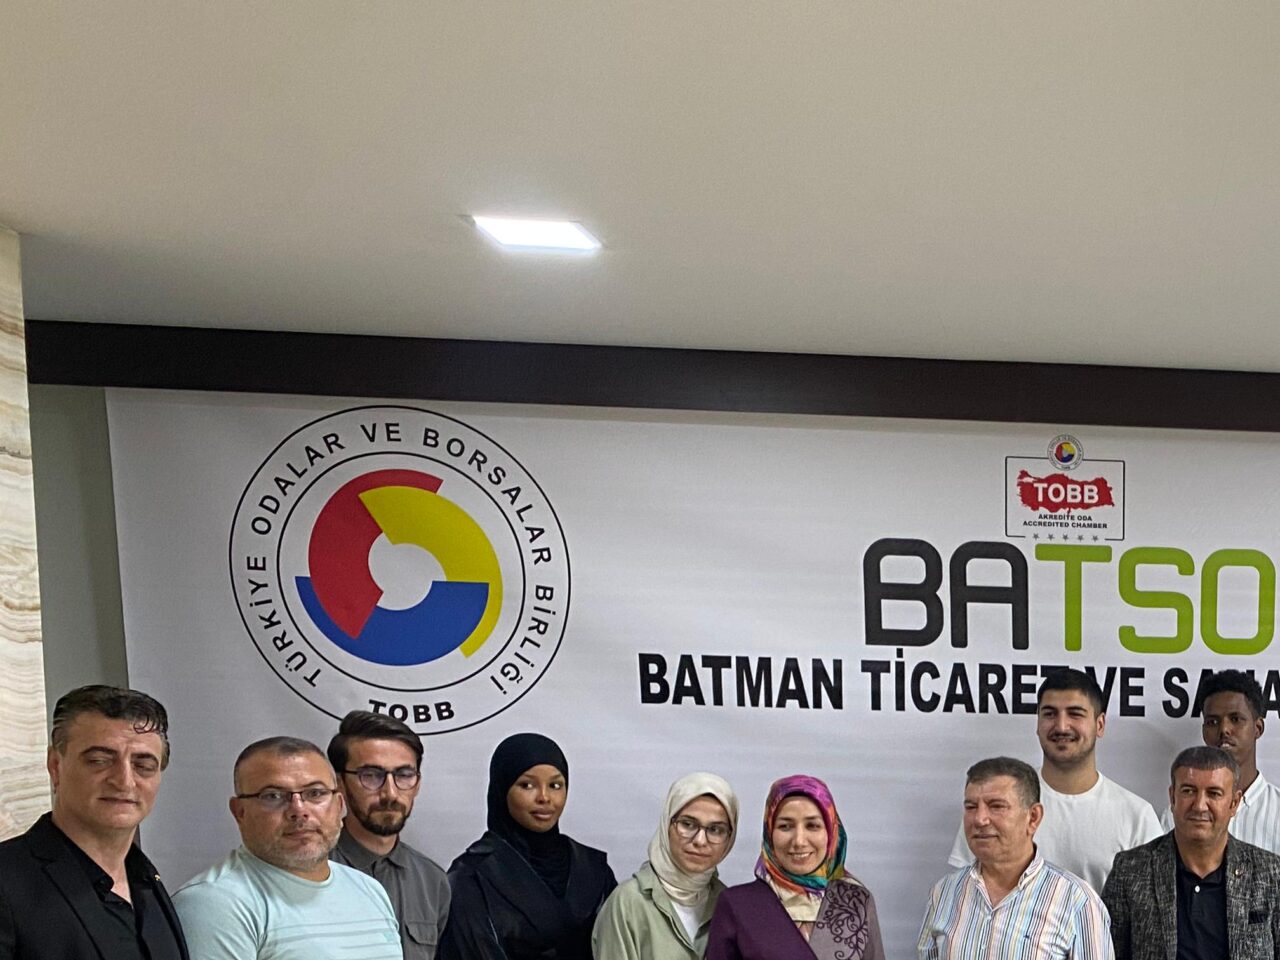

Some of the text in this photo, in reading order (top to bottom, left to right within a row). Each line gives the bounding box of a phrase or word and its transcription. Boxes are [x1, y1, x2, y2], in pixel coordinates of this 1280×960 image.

[1033, 483, 1099, 504] TOBB
[247, 422, 556, 695] TÜRKİYE ODALAR VE BORSALAR BİRLİĞİ
[863, 537, 1276, 655] BATSO
[368, 699, 454, 723] TOBB
[638, 652, 844, 711] BATMAN
